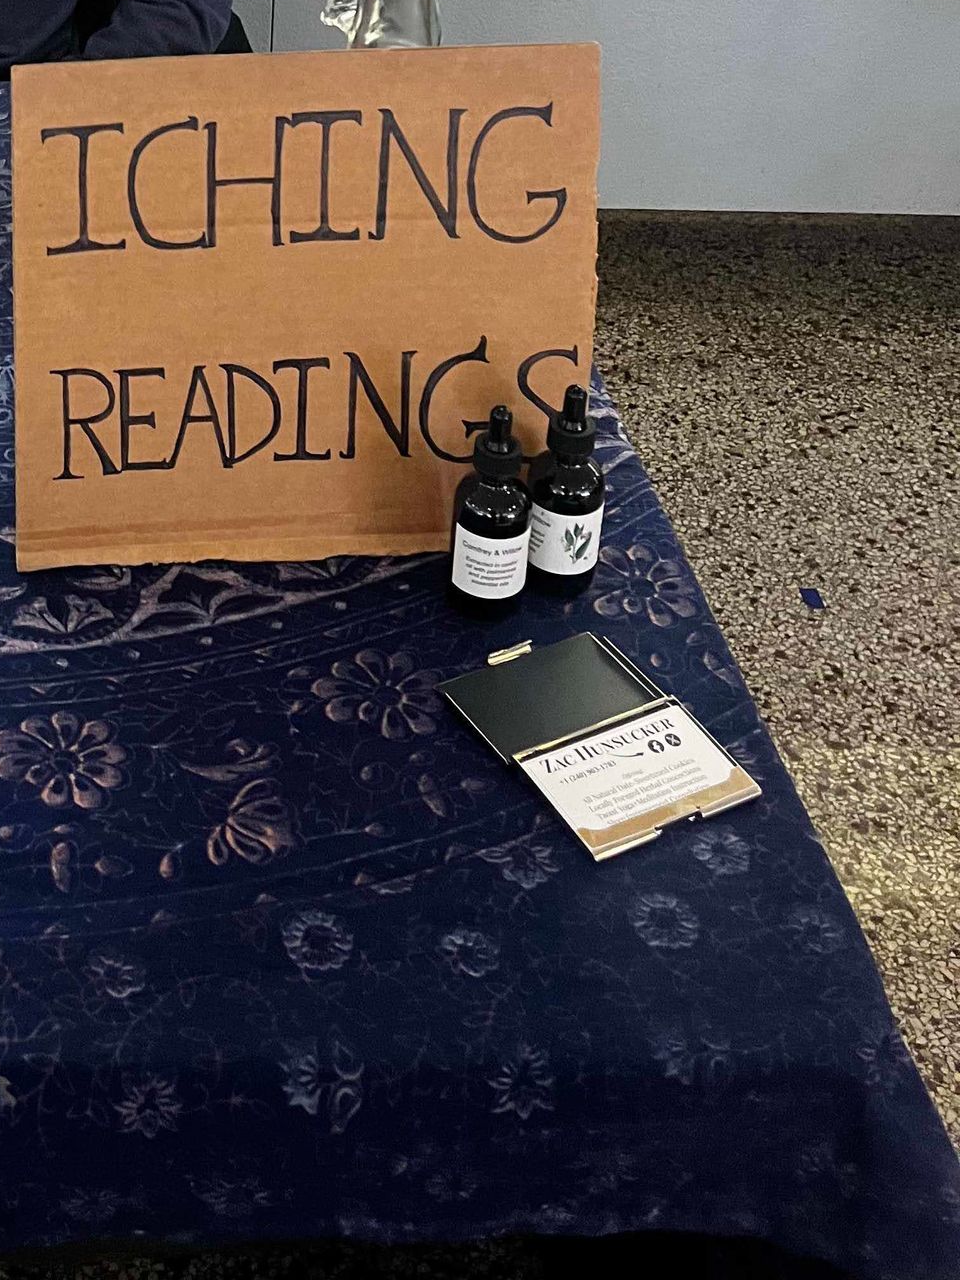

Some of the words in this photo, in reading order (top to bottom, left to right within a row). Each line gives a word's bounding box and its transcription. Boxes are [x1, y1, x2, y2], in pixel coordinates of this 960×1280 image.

[463, 540, 492, 556] Comfrey
[540, 753, 577, 774] ZAC
[575, 719, 675, 761] HUNSUCKER
